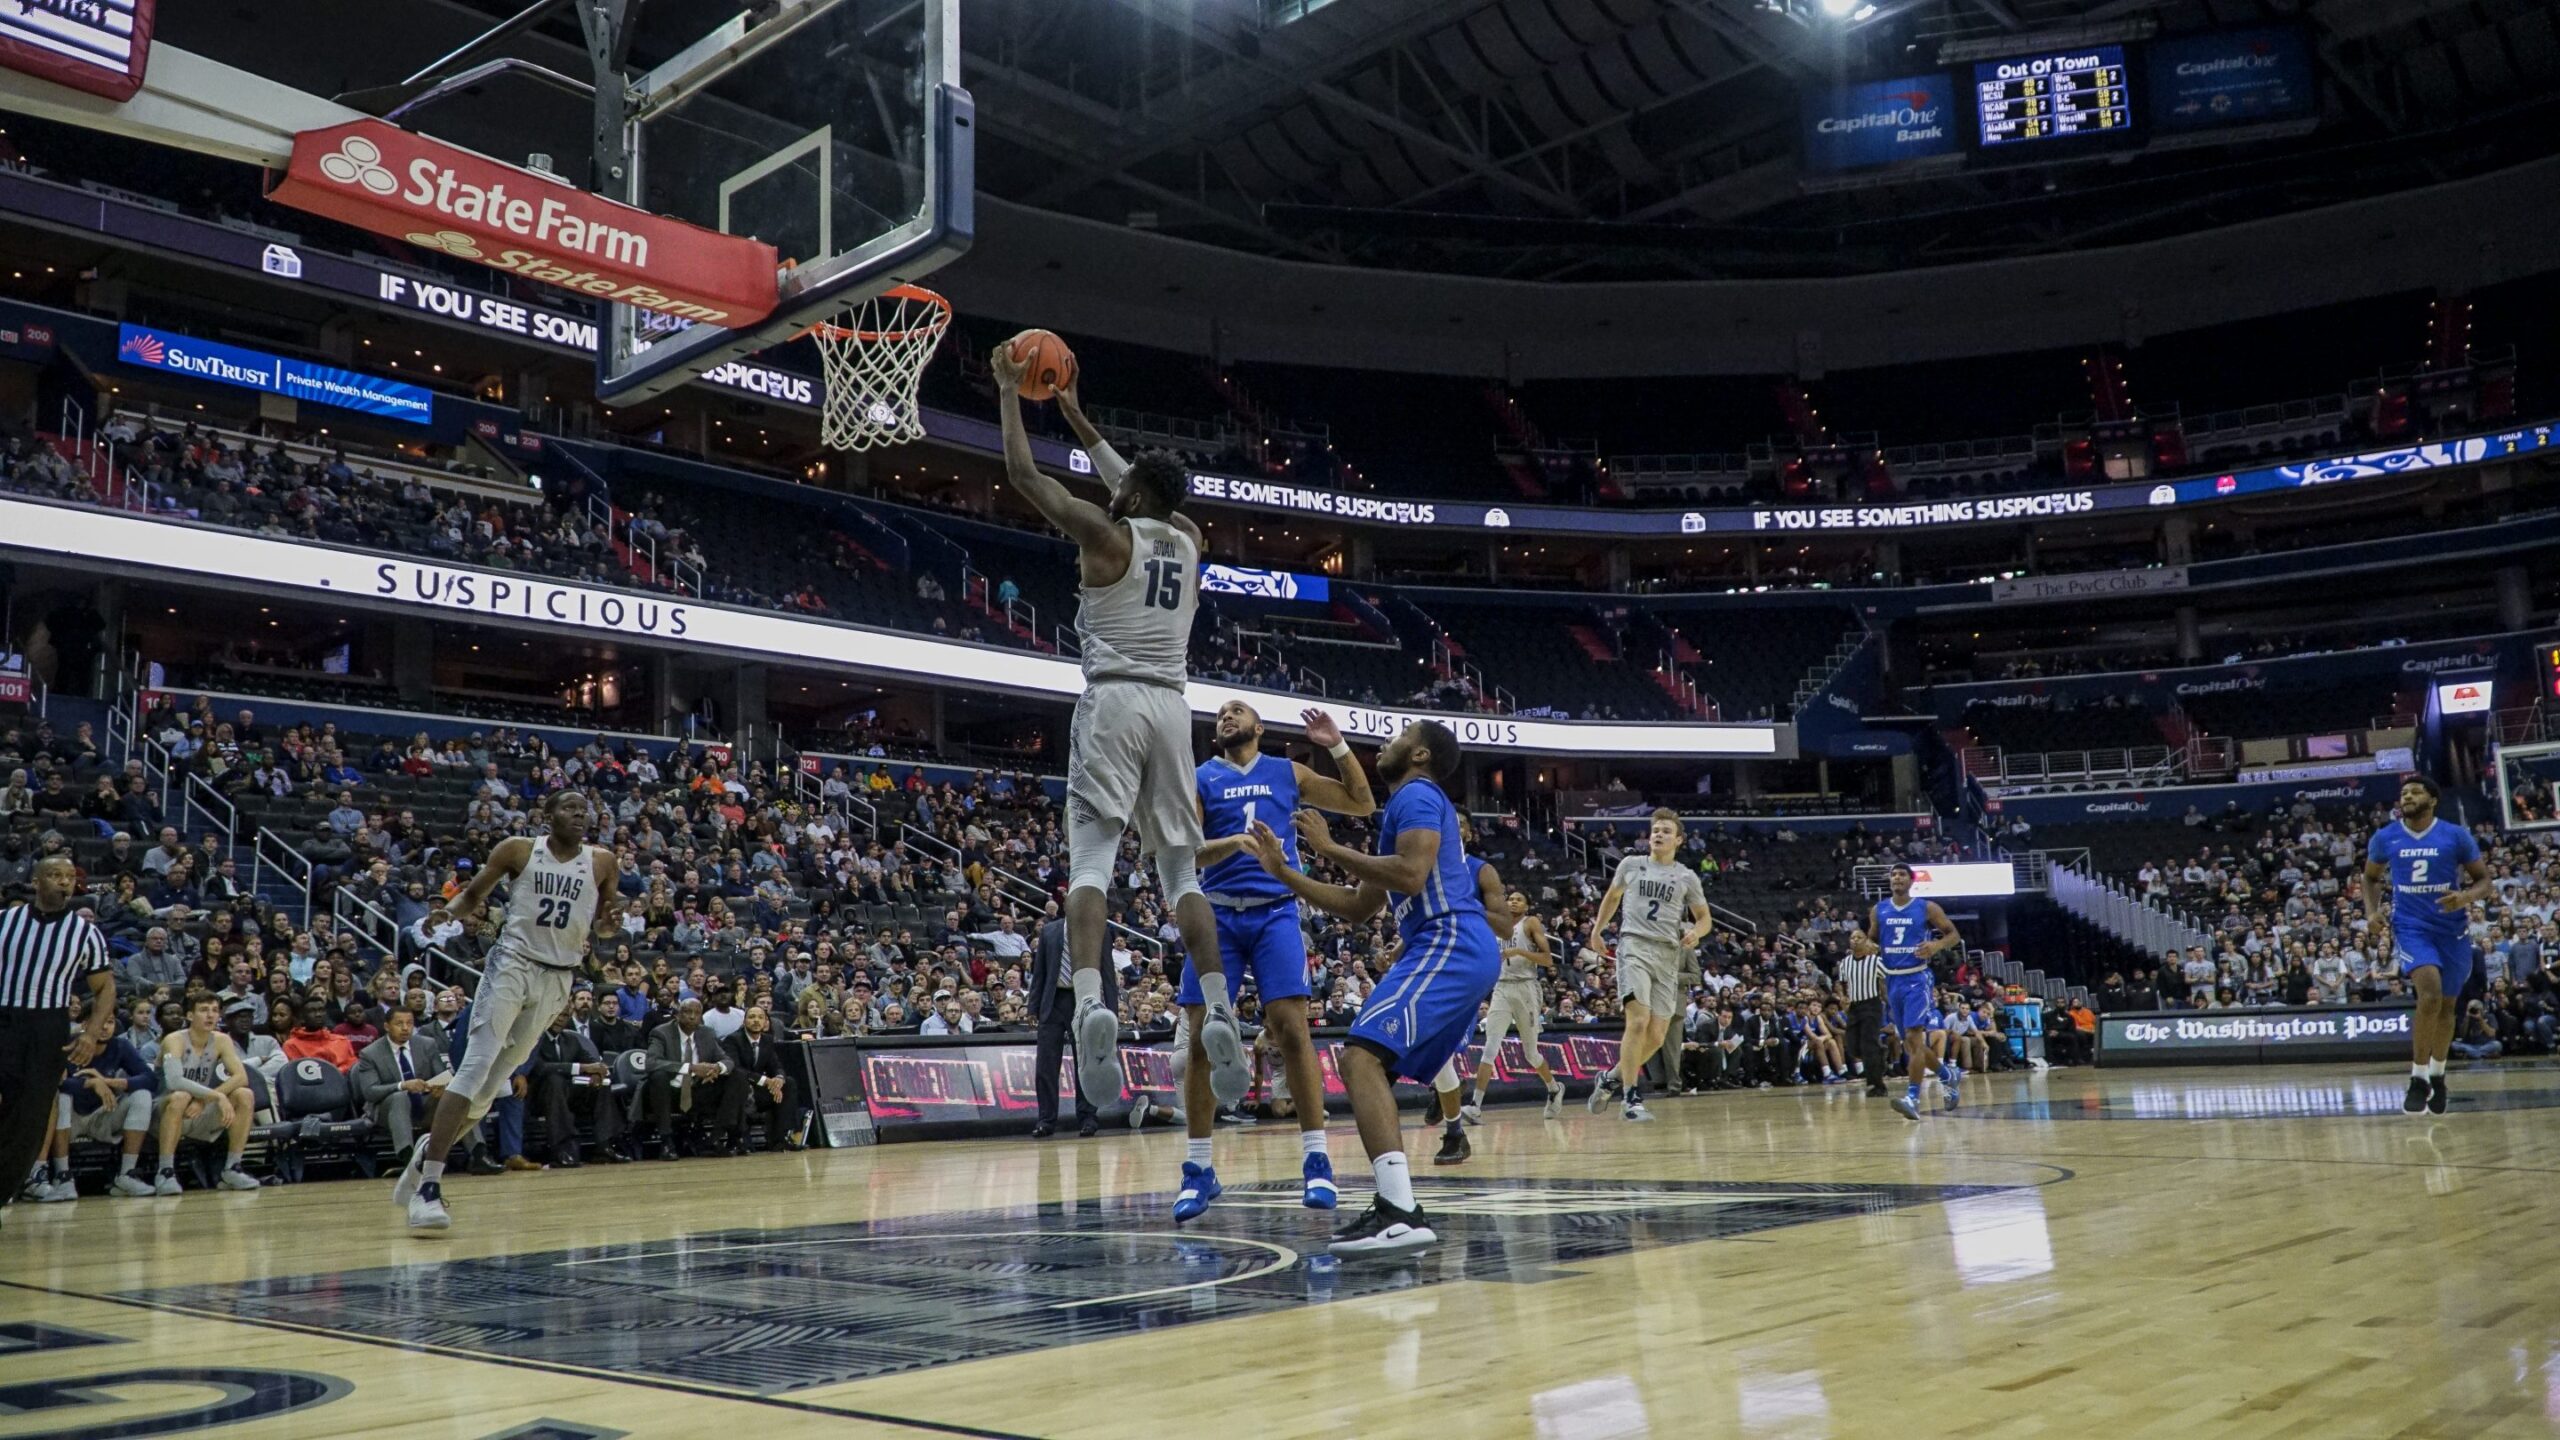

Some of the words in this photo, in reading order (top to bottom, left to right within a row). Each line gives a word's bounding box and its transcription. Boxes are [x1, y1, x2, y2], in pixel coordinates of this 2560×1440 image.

[1997, 63, 2028, 79] Out
[2031, 59, 2051, 74] Of
[2055, 55, 2099, 71] Town
[2110, 70, 2117, 82] 2
[2037, 80, 2045, 91] 2
[2039, 100, 2047, 111] 2
[2112, 91, 2119, 103] 2
[2041, 120, 2049, 131] 2
[2114, 111, 2121, 123] 2
[1896, 126, 1942, 142] Bank
[380, 273, 405, 301] IF
[412, 281, 472, 319] YOU
[479, 300, 528, 333] SEE
[27, 328, 50, 342] 200
[287, 372, 322, 388] Private
[324, 380, 360, 396] Wealth
[362, 389, 428, 412] Management
[2507, 442, 2515, 453] 2
[2538, 434, 2547, 446] 2
[1193, 475, 1226, 498] SEE
[1230, 480, 1332, 513] SOMETHING
[1754, 511, 1770, 529] IF
[1774, 510, 1815, 529] YOU
[1820, 508, 1853, 528] SEE
[1857, 501, 1973, 527] SOMETHING
[1153, 539, 1176, 558] GOVAN
[1144, 558, 1182, 611] 15
[2032, 582, 2063, 597] The
[2069, 578, 2105, 593] PwC
[2110, 574, 2146, 590] Club
[0, 684, 23, 697] 101
[803, 759, 817, 770] 121
[1223, 784, 1273, 799] CENTRAL
[1242, 801, 1256, 834] 1
[2400, 848, 2439, 858] CENTRAL
[2411, 859, 2428, 883] 2
[534, 871, 584, 901] HOYAS
[1640, 879, 1675, 902] HOYAS
[536, 897, 571, 930] 23
[1646, 900, 1660, 922] 2
[1886, 917, 1913, 926] CENTRAL
[1892, 926, 1906, 945] 3
[2125, 1022, 2170, 1043] The
[2176, 1018, 2338, 1041] Washington
[2343, 1013, 2410, 1039] Post
